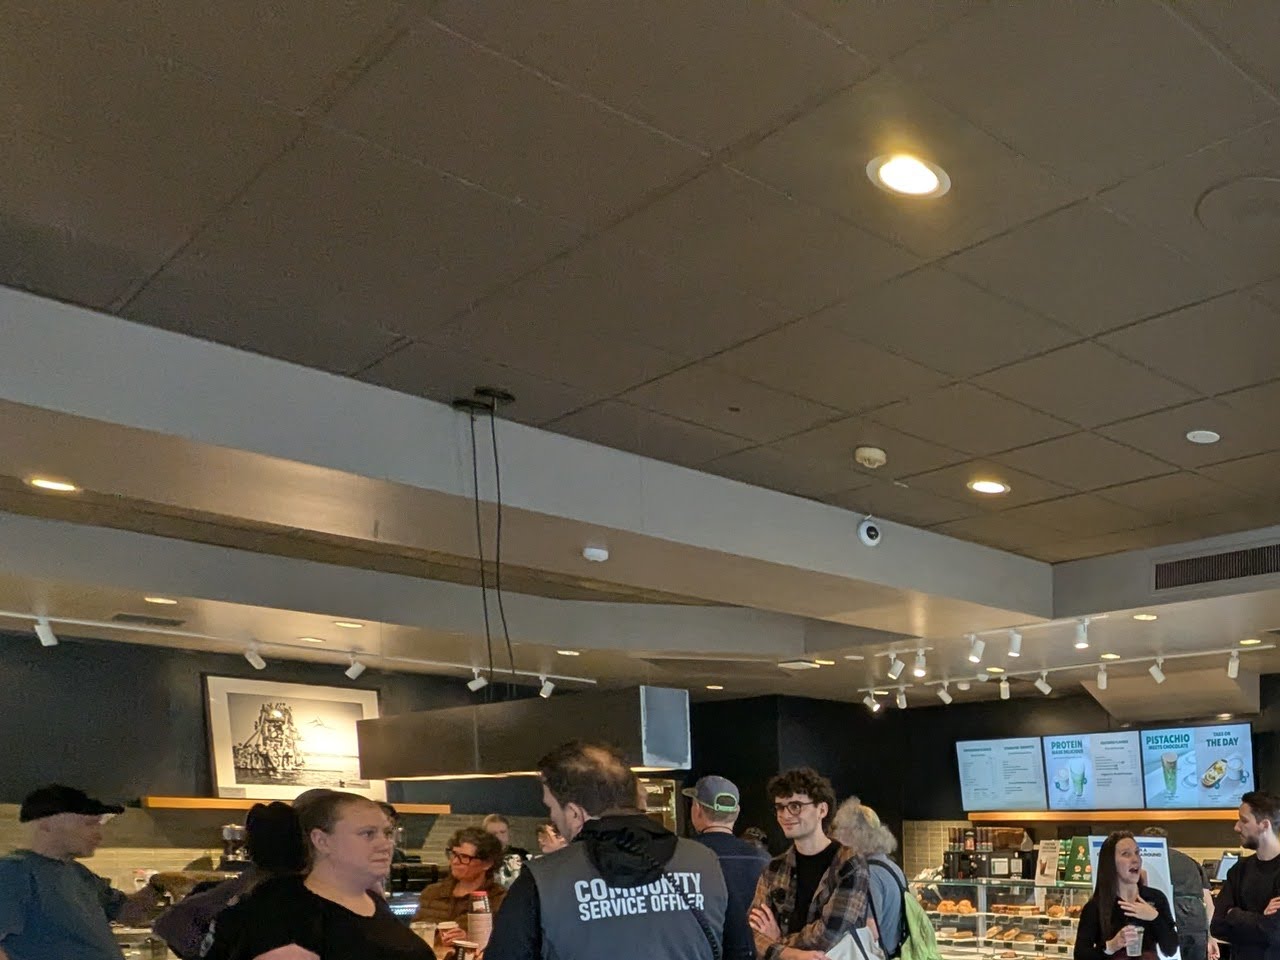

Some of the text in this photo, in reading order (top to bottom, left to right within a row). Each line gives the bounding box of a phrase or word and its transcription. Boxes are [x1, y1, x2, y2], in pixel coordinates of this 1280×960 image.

[1146, 733, 1190, 745] PISTACHIO
[1206, 736, 1239, 747] THE DAY
[1051, 740, 1083, 750] PROTEIN
[578, 896, 647, 922] SERVICE
